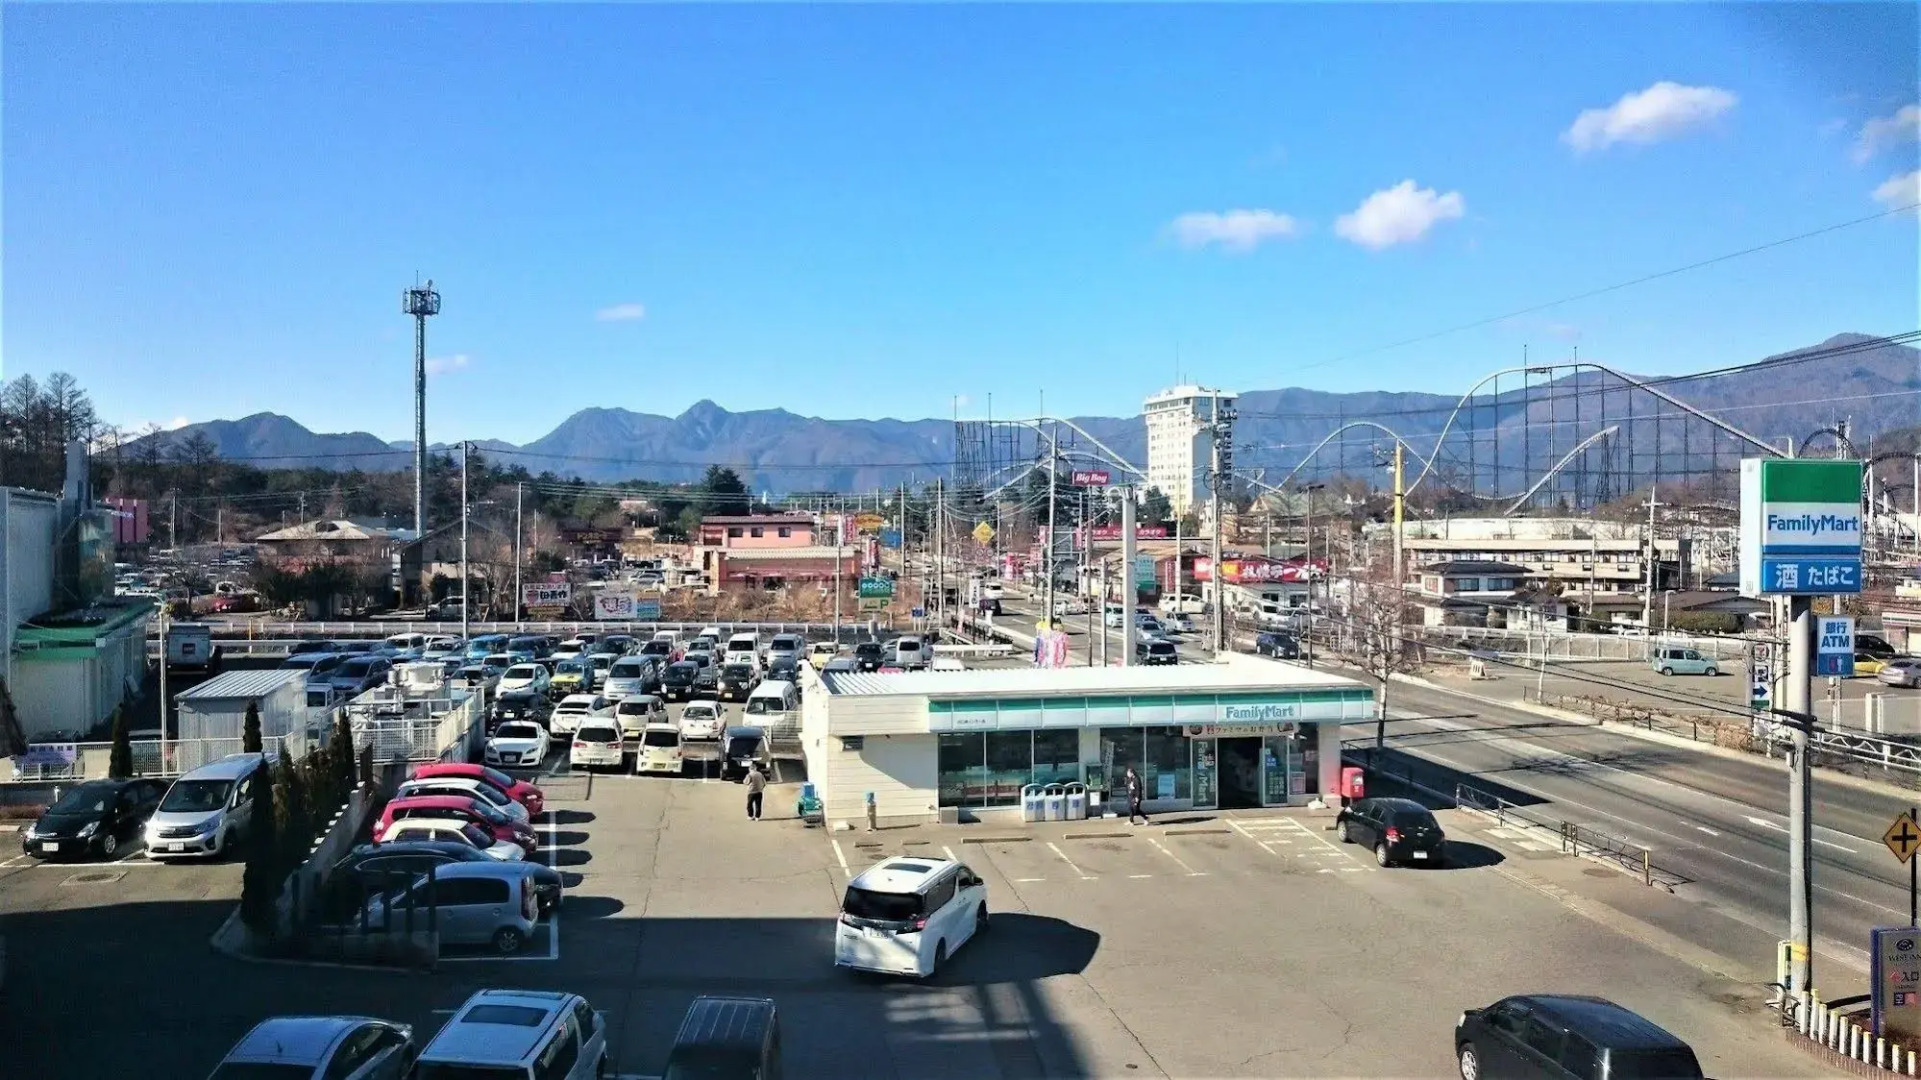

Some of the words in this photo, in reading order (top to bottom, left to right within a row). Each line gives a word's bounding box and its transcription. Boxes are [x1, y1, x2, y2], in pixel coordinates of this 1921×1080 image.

[1076, 473, 1090, 483] Big
[1091, 474, 1107, 483] Boy
[1767, 514, 1858, 536] FamilyMart
[1775, 563, 1799, 589] 酒
[1807, 565, 1854, 586] たばこ
[1825, 621, 1848, 634] 銀行
[1821, 635, 1850, 648] ATM
[1226, 705, 1294, 721] FamilyMart
[1901, 971, 1920, 982] 入口
